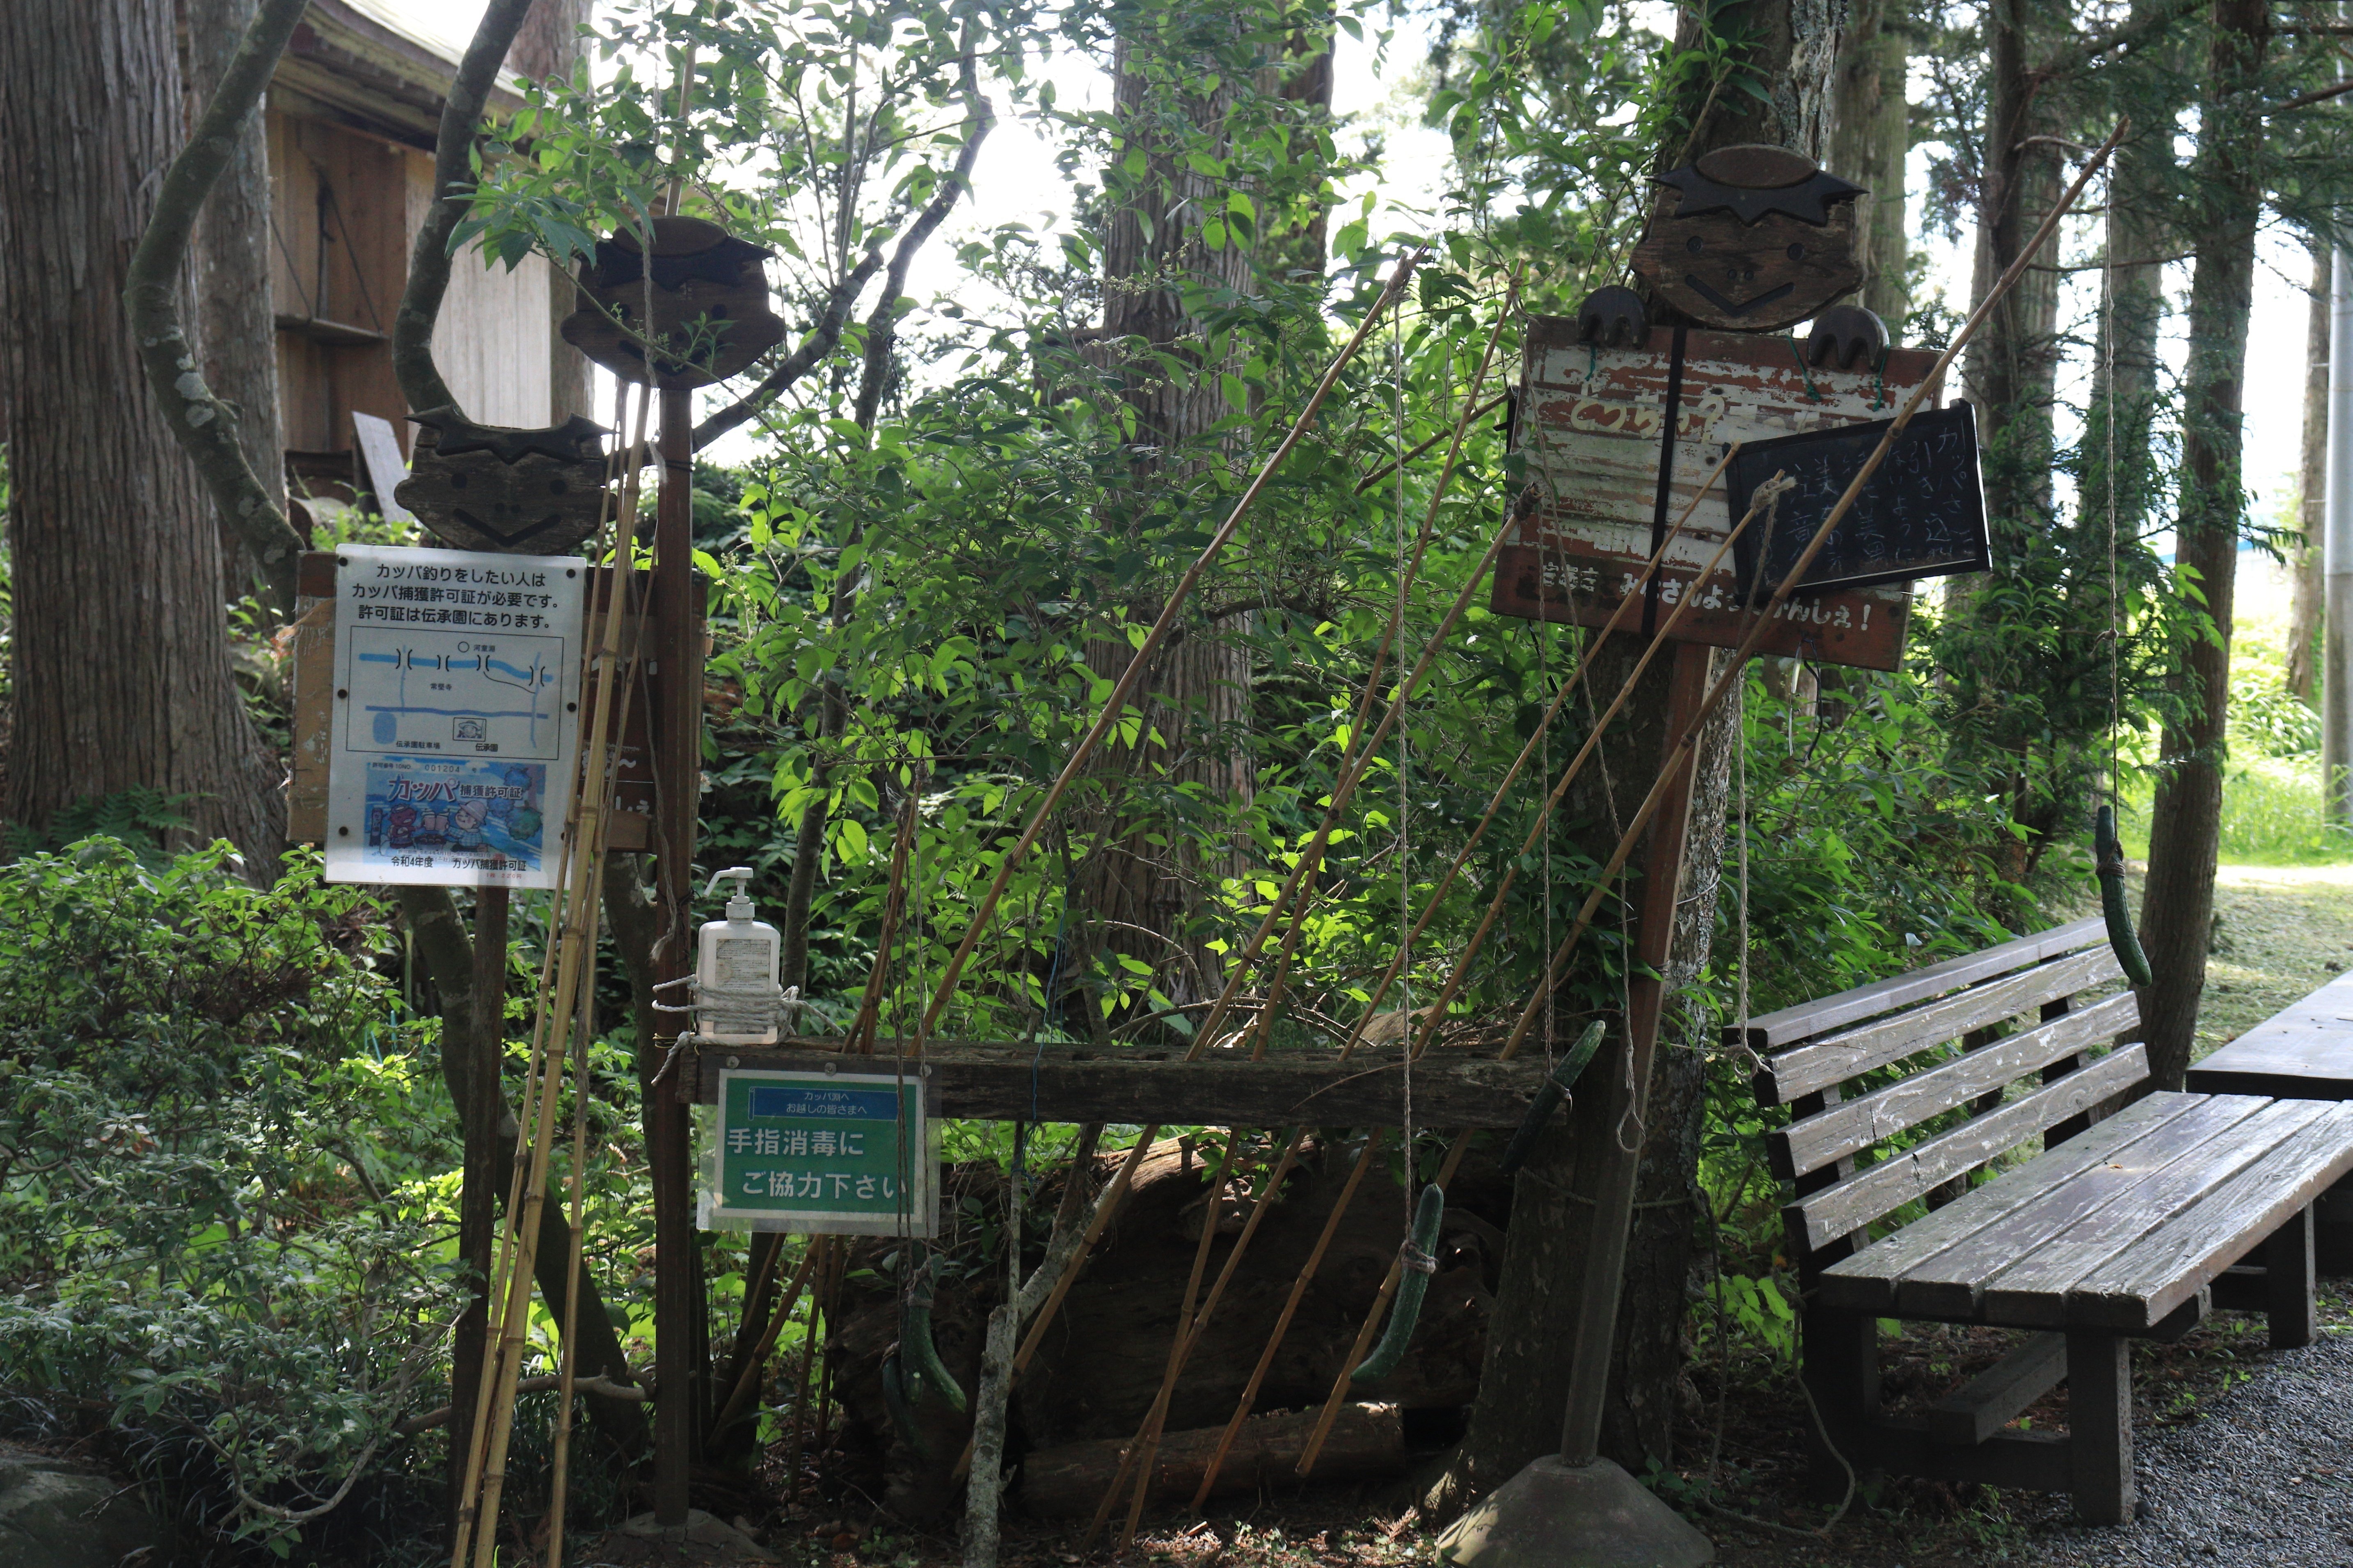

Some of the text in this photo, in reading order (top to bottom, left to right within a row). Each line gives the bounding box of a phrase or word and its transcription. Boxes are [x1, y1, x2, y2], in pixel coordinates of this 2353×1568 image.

[377, 563, 545, 587] カッパ釣りをしたい人は
[352, 583, 558, 608] カッパ捕獲許可証が必要です。
[358, 604, 550, 629] 許可証は伝承園にあります。
[396, 740, 441, 750] 伝承園駐車場
[475, 743, 498, 752] 伝承園
[424, 764, 460, 773] 001204
[387, 774, 524, 802] カッパ 捕獲許可証
[391, 855, 433, 869] 令和4年度
[453, 858, 527, 872] カッパ捕獲許可証
[804, 1092, 850, 1102] カッパ淵へ
[786, 1103, 867, 1115] お越しの皆さまへ
[727, 1127, 864, 1157] 手指消毒に
[742, 1170, 906, 1200] ご協力下さい
